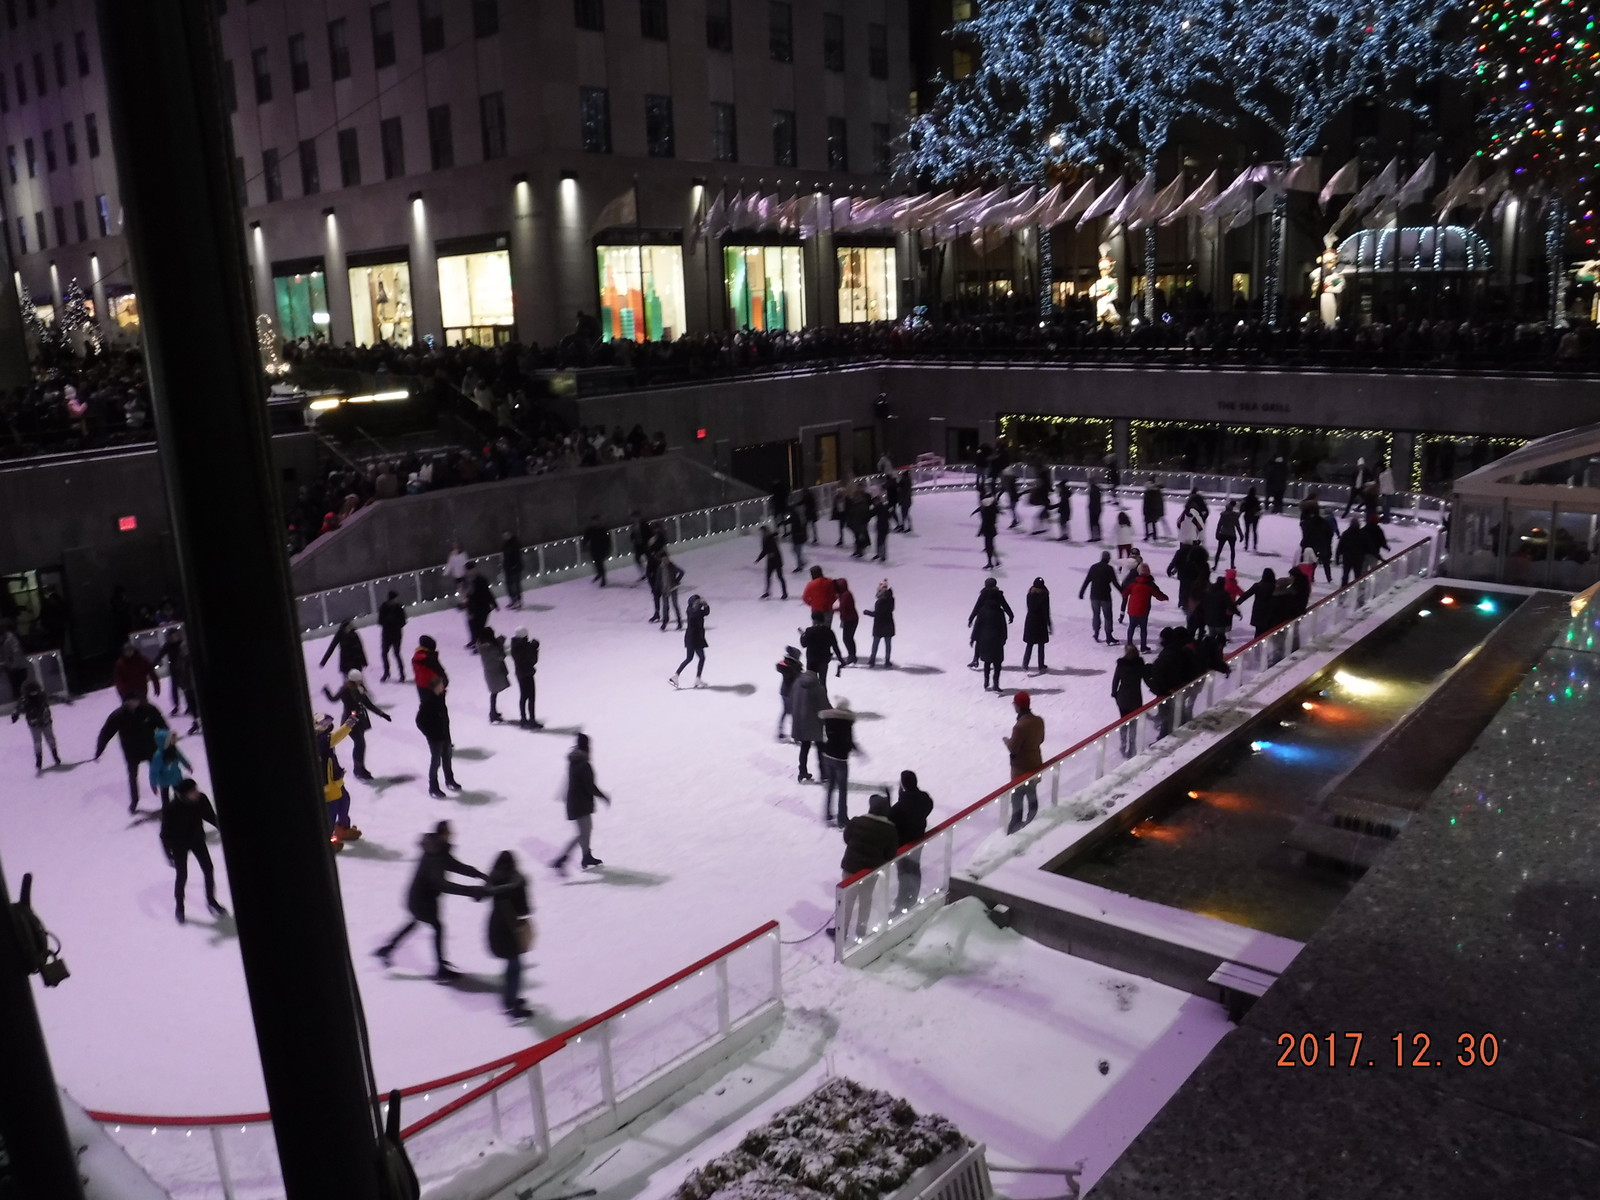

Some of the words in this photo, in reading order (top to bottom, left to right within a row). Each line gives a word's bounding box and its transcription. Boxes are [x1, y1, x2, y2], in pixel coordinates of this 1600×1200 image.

[1218, 401, 1236, 410] THE
[1240, 402, 1258, 411] SEA
[1262, 403, 1291, 412] GRILL
